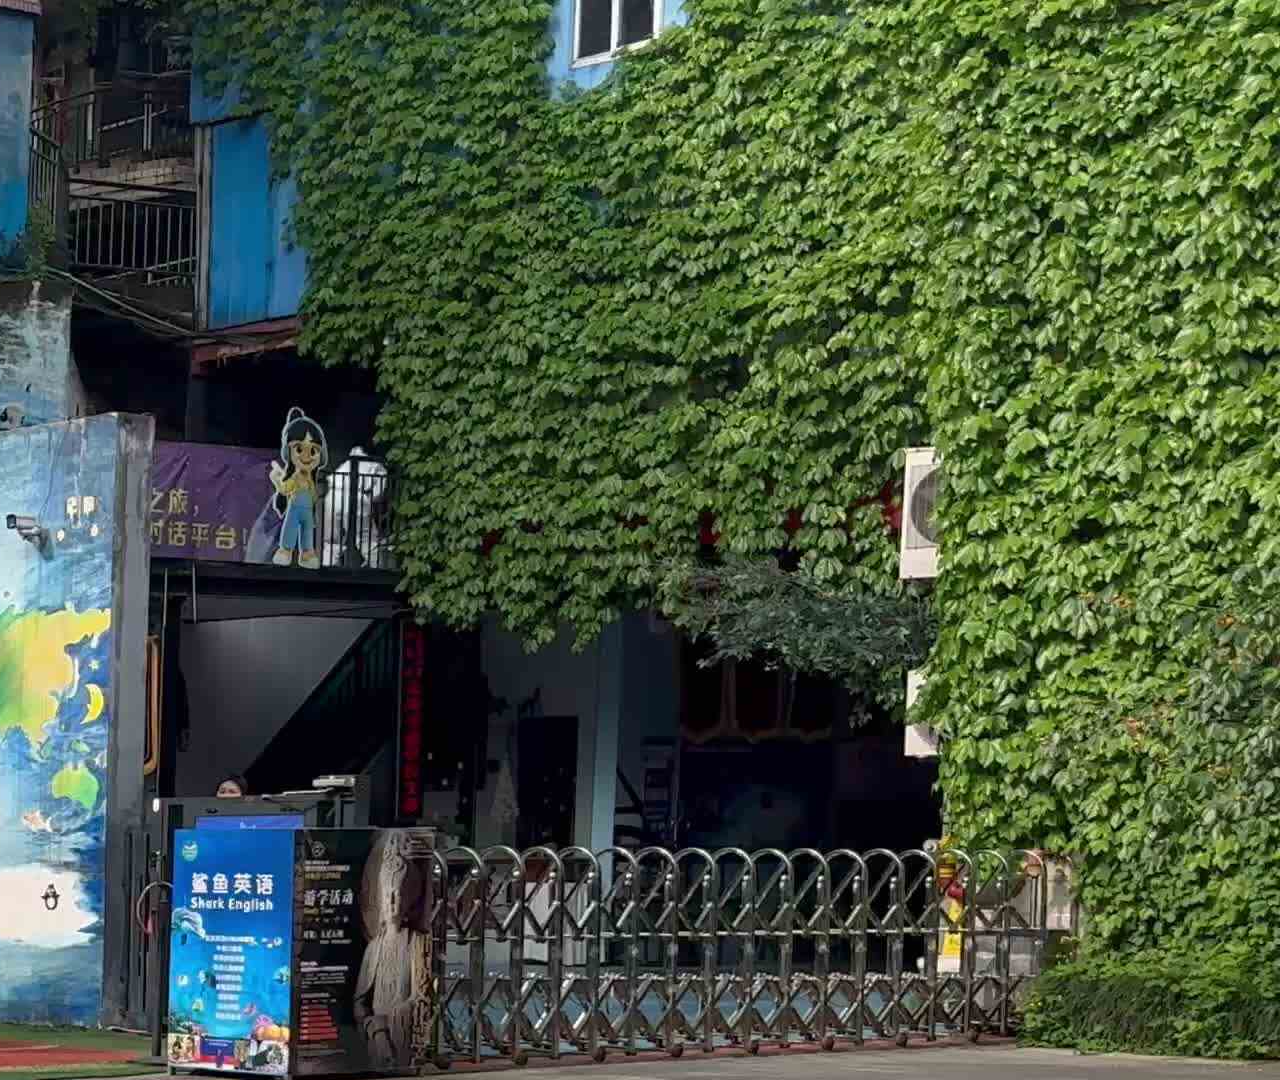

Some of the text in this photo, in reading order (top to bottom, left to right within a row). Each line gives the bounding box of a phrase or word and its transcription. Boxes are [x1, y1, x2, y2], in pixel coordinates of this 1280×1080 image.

[191, 872, 274, 895] 鲨鱼英语
[190, 896, 273, 912] Shark English
